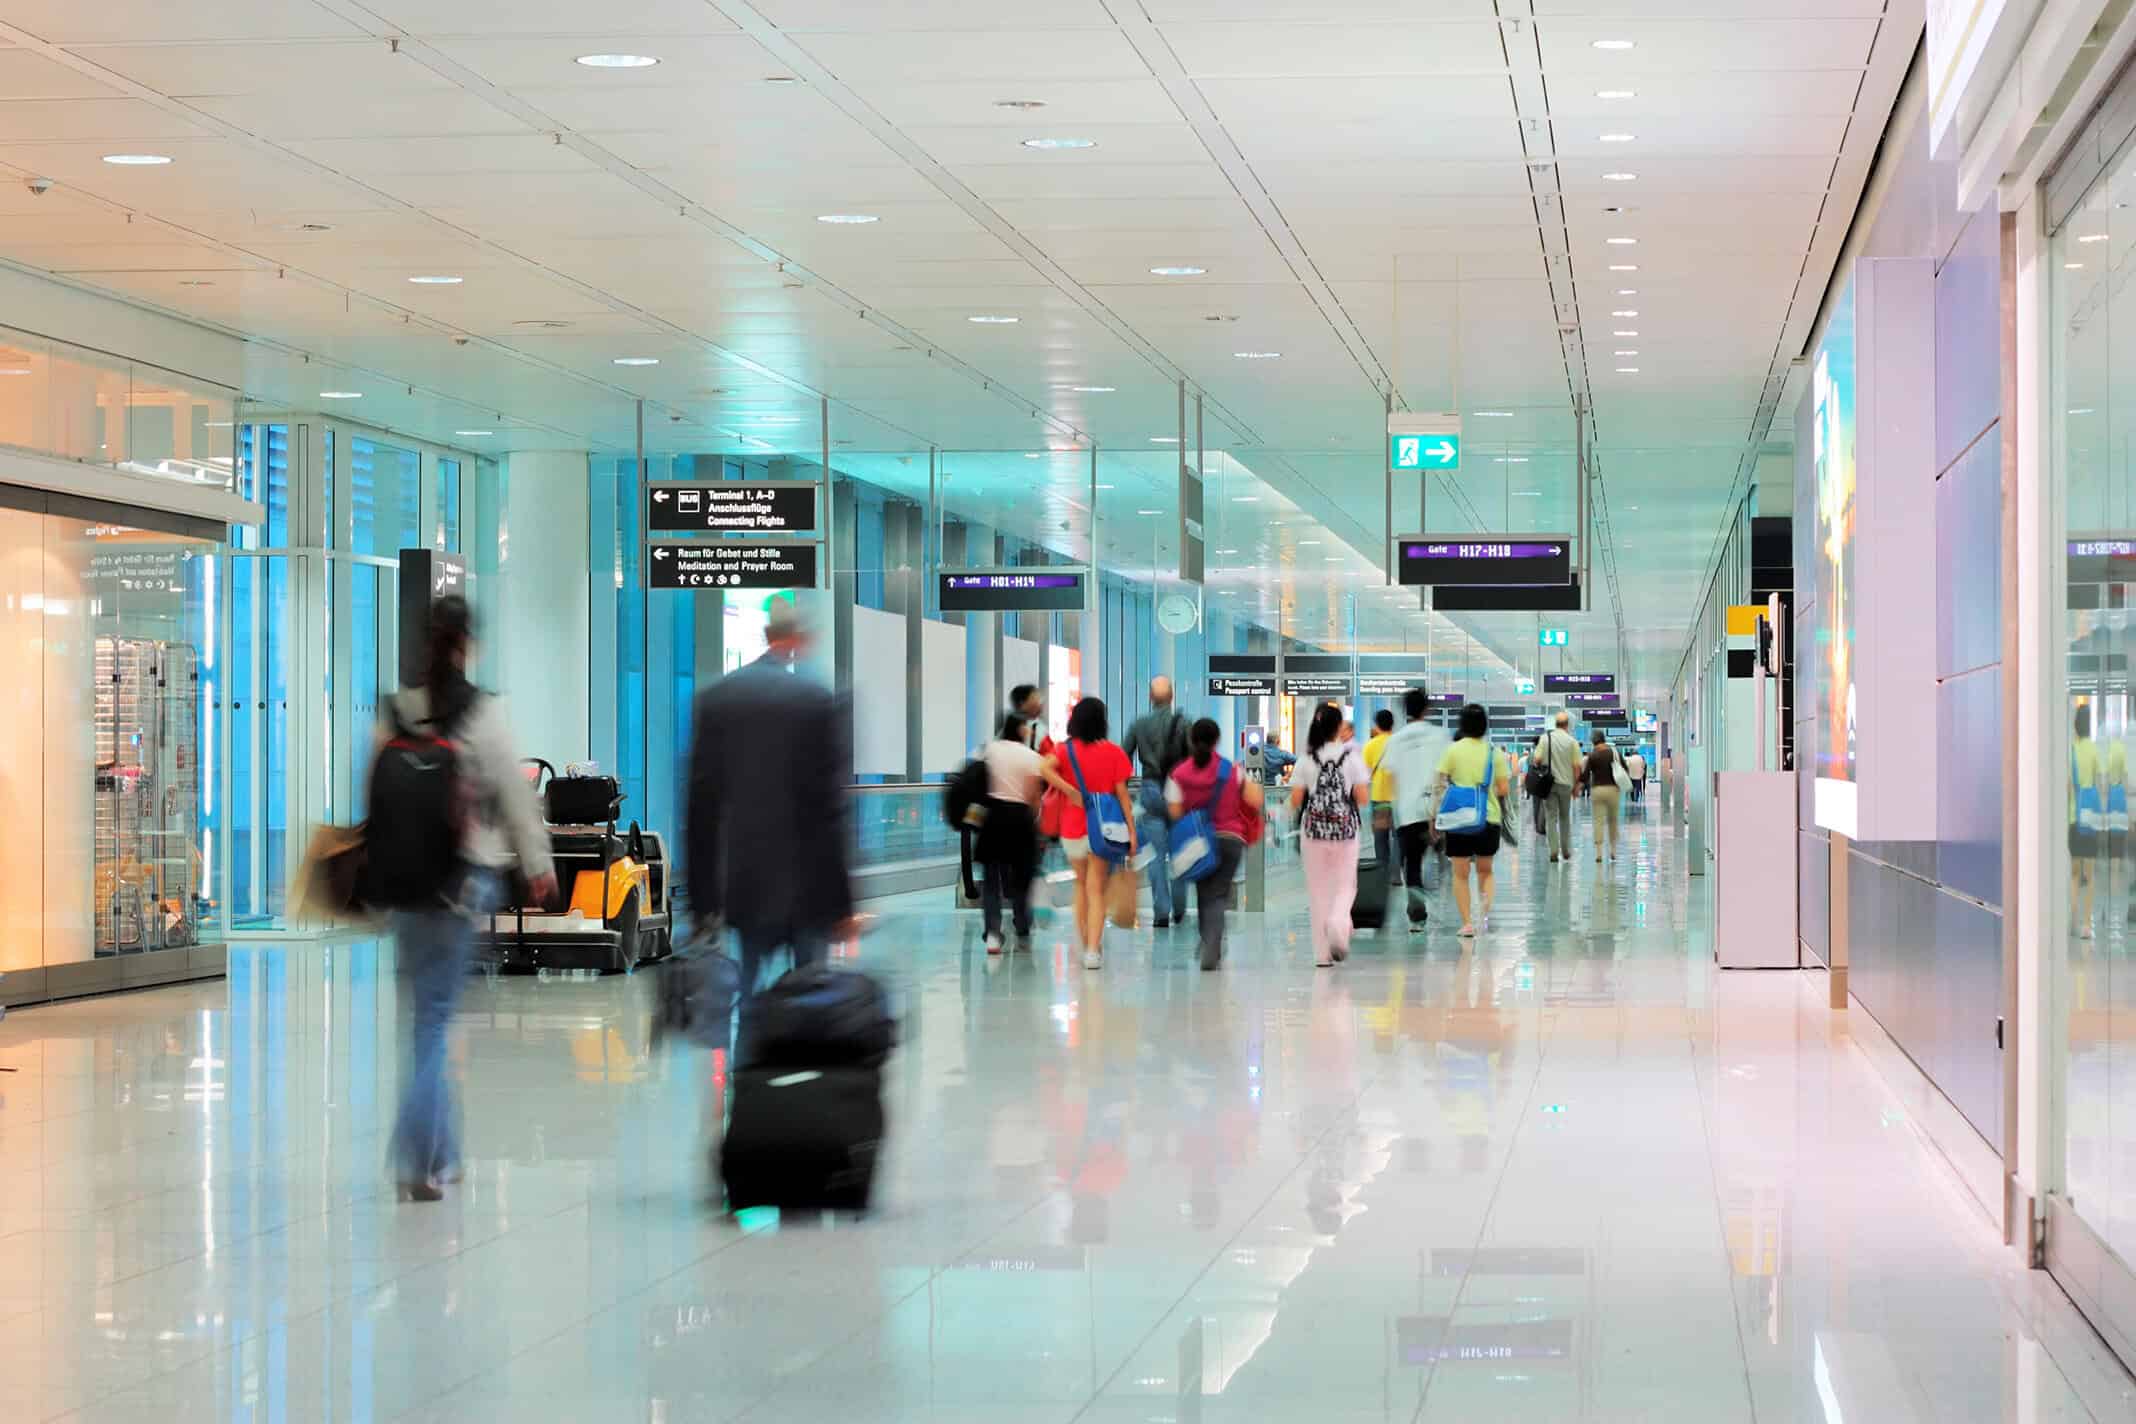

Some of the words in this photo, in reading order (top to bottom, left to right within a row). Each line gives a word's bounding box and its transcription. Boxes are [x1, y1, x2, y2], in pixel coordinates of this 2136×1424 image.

[708, 490, 744, 500] Terminal
[708, 503, 772, 513] Anschlussflüge
[707, 516, 755, 527] Connecting
[756, 516, 785, 527] Flights
[678, 549, 701, 558] Raum
[702, 549, 715, 558] für
[716, 549, 741, 558] Gebet
[742, 549, 758, 558] und
[760, 549, 781, 558] Stille
[1428, 545, 1447, 553] Gate
[1459, 545, 1512, 557] H17-H18
[678, 561, 722, 571] Meditation
[724, 561, 739, 571] and
[741, 561, 768, 573] Prayer
[770, 561, 794, 571] Room
[990, 576, 1035, 587] H01-H14
